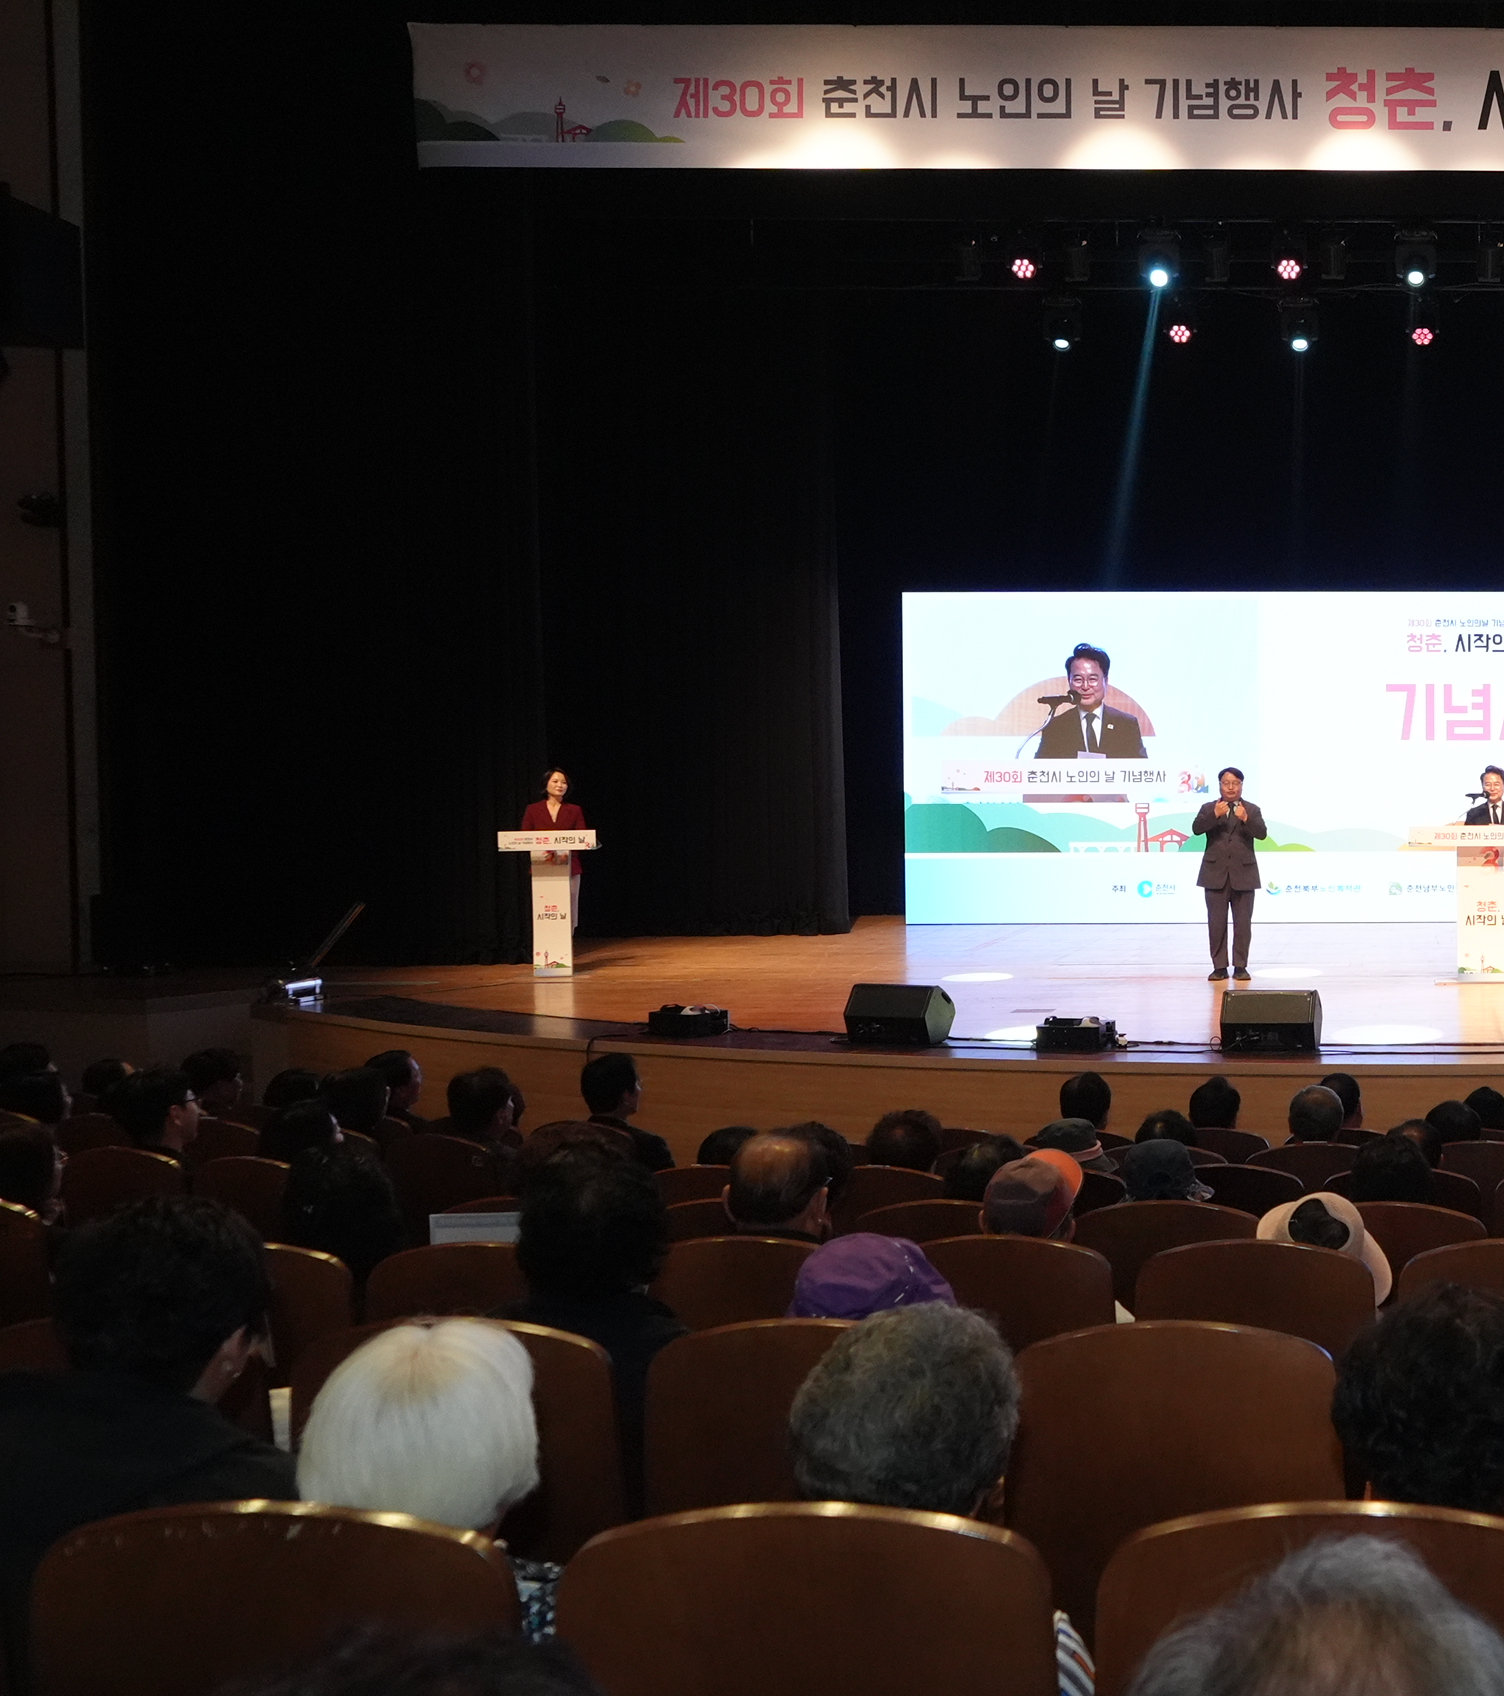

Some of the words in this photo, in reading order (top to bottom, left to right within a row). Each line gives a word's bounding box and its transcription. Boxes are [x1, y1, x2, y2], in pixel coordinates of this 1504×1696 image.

[672, 76, 805, 119] 제30회
[821, 76, 939, 119] 춘천시
[956, 76, 1072, 120] 노인의
[1091, 76, 1130, 120] 날
[1144, 77, 1303, 120] 기념행사
[1324, 66, 1454, 132] 청춘,
[1407, 619, 1433, 628] 제30회
[1434, 619, 1457, 628] 춘천시
[1406, 633, 1448, 653] 청춘,
[983, 770, 1023, 783] 제30회
[1027, 770, 1062, 783] 춘천시
[1066, 770, 1101, 783] 노인의
[1104, 770, 1116, 783] 날
[1120, 770, 1167, 783] 기념행사
[1433, 832, 1458, 840] 제30회
[1459, 832, 1481, 840] 춘천시
[1112, 885, 1127, 893] 주최
[1406, 884, 1456, 893] 춘천남부노인
[1465, 914, 1497, 926] 시작의
